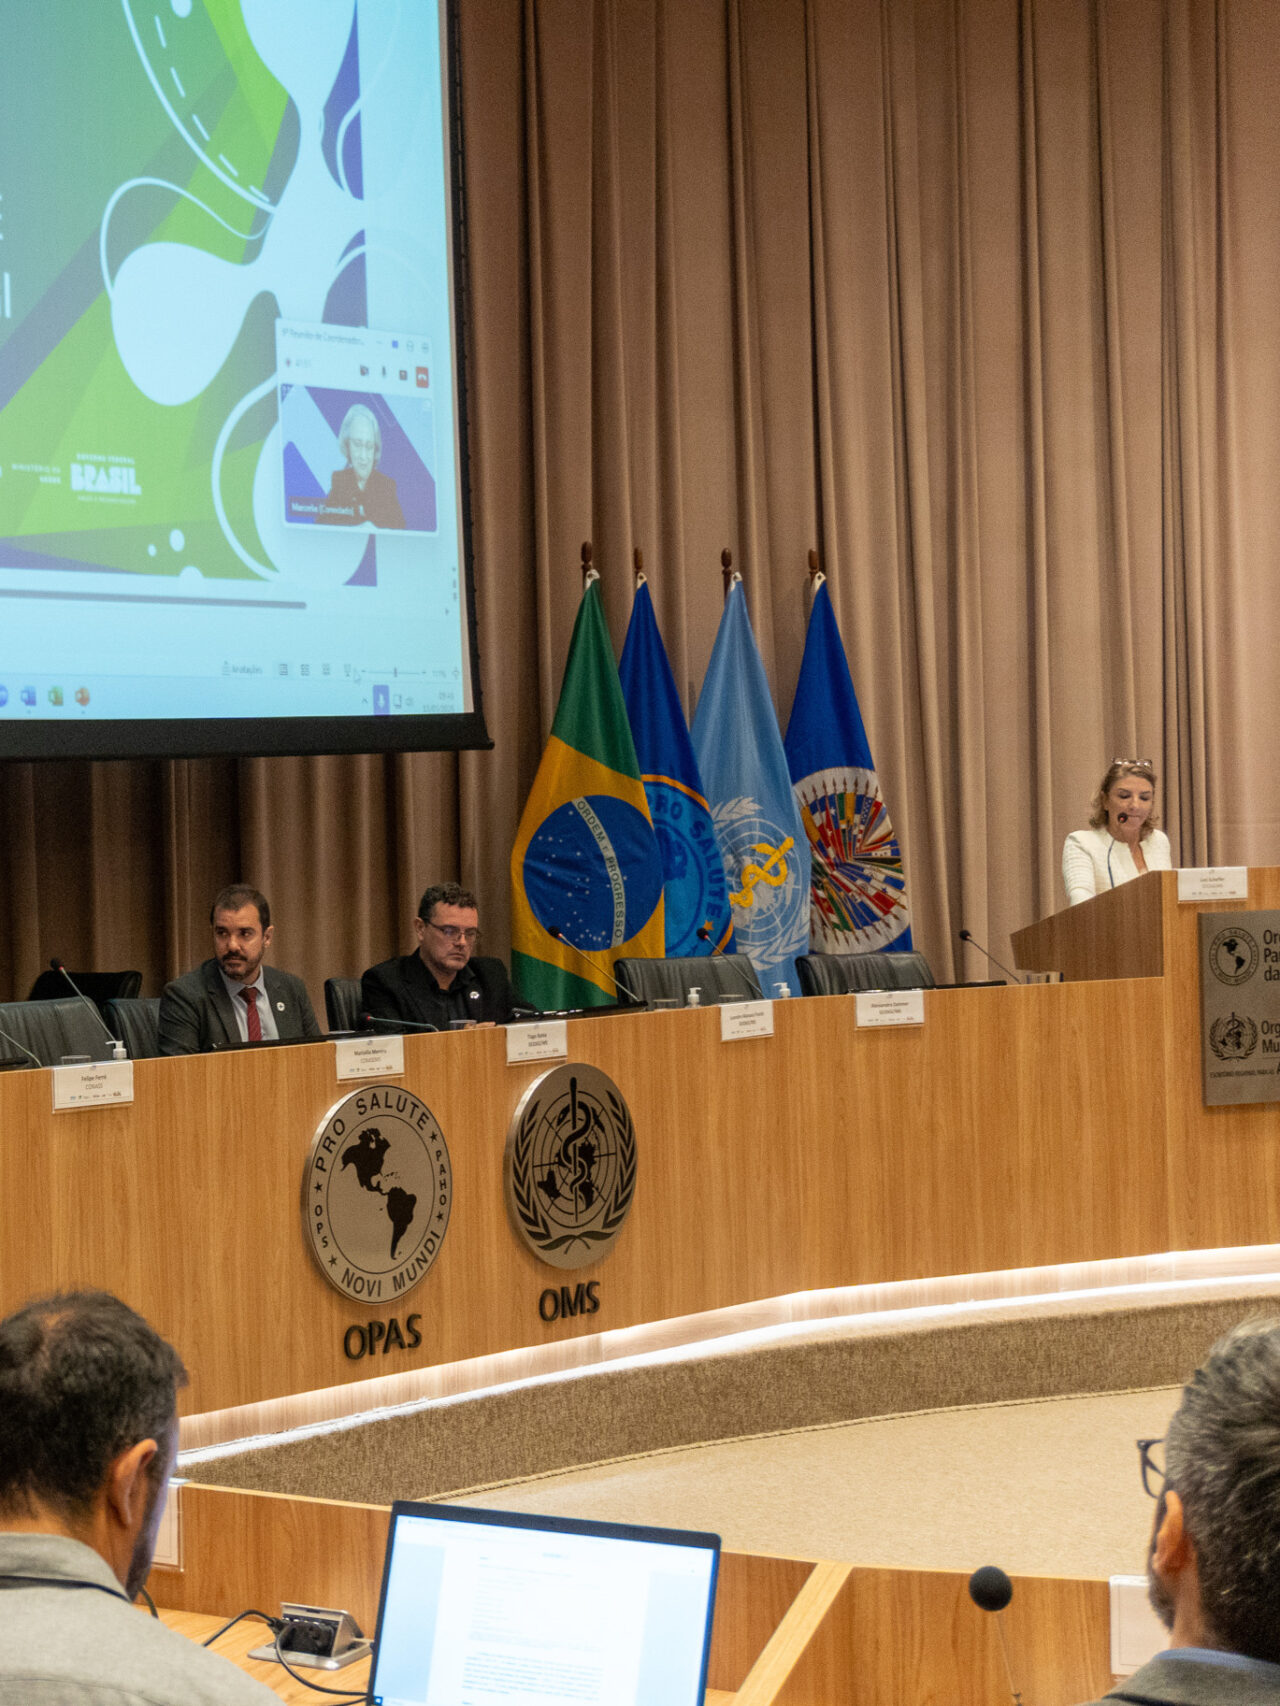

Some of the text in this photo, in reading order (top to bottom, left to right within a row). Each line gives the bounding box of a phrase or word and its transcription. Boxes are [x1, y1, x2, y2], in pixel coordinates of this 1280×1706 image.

[71, 463, 142, 495] BRASIL
[576, 799, 606, 843] ORDEM
[606, 856, 626, 938] PROGRESSO
[689, 820, 726, 918] SALUTE
[315, 1091, 430, 1172] PRO SALUTE
[435, 1150, 447, 1206] PAHO
[315, 1205, 329, 1248] OPS
[341, 1230, 440, 1298] NOVI MUNDI
[539, 1281, 600, 1322] OMS
[344, 1313, 422, 1361] OPAS
